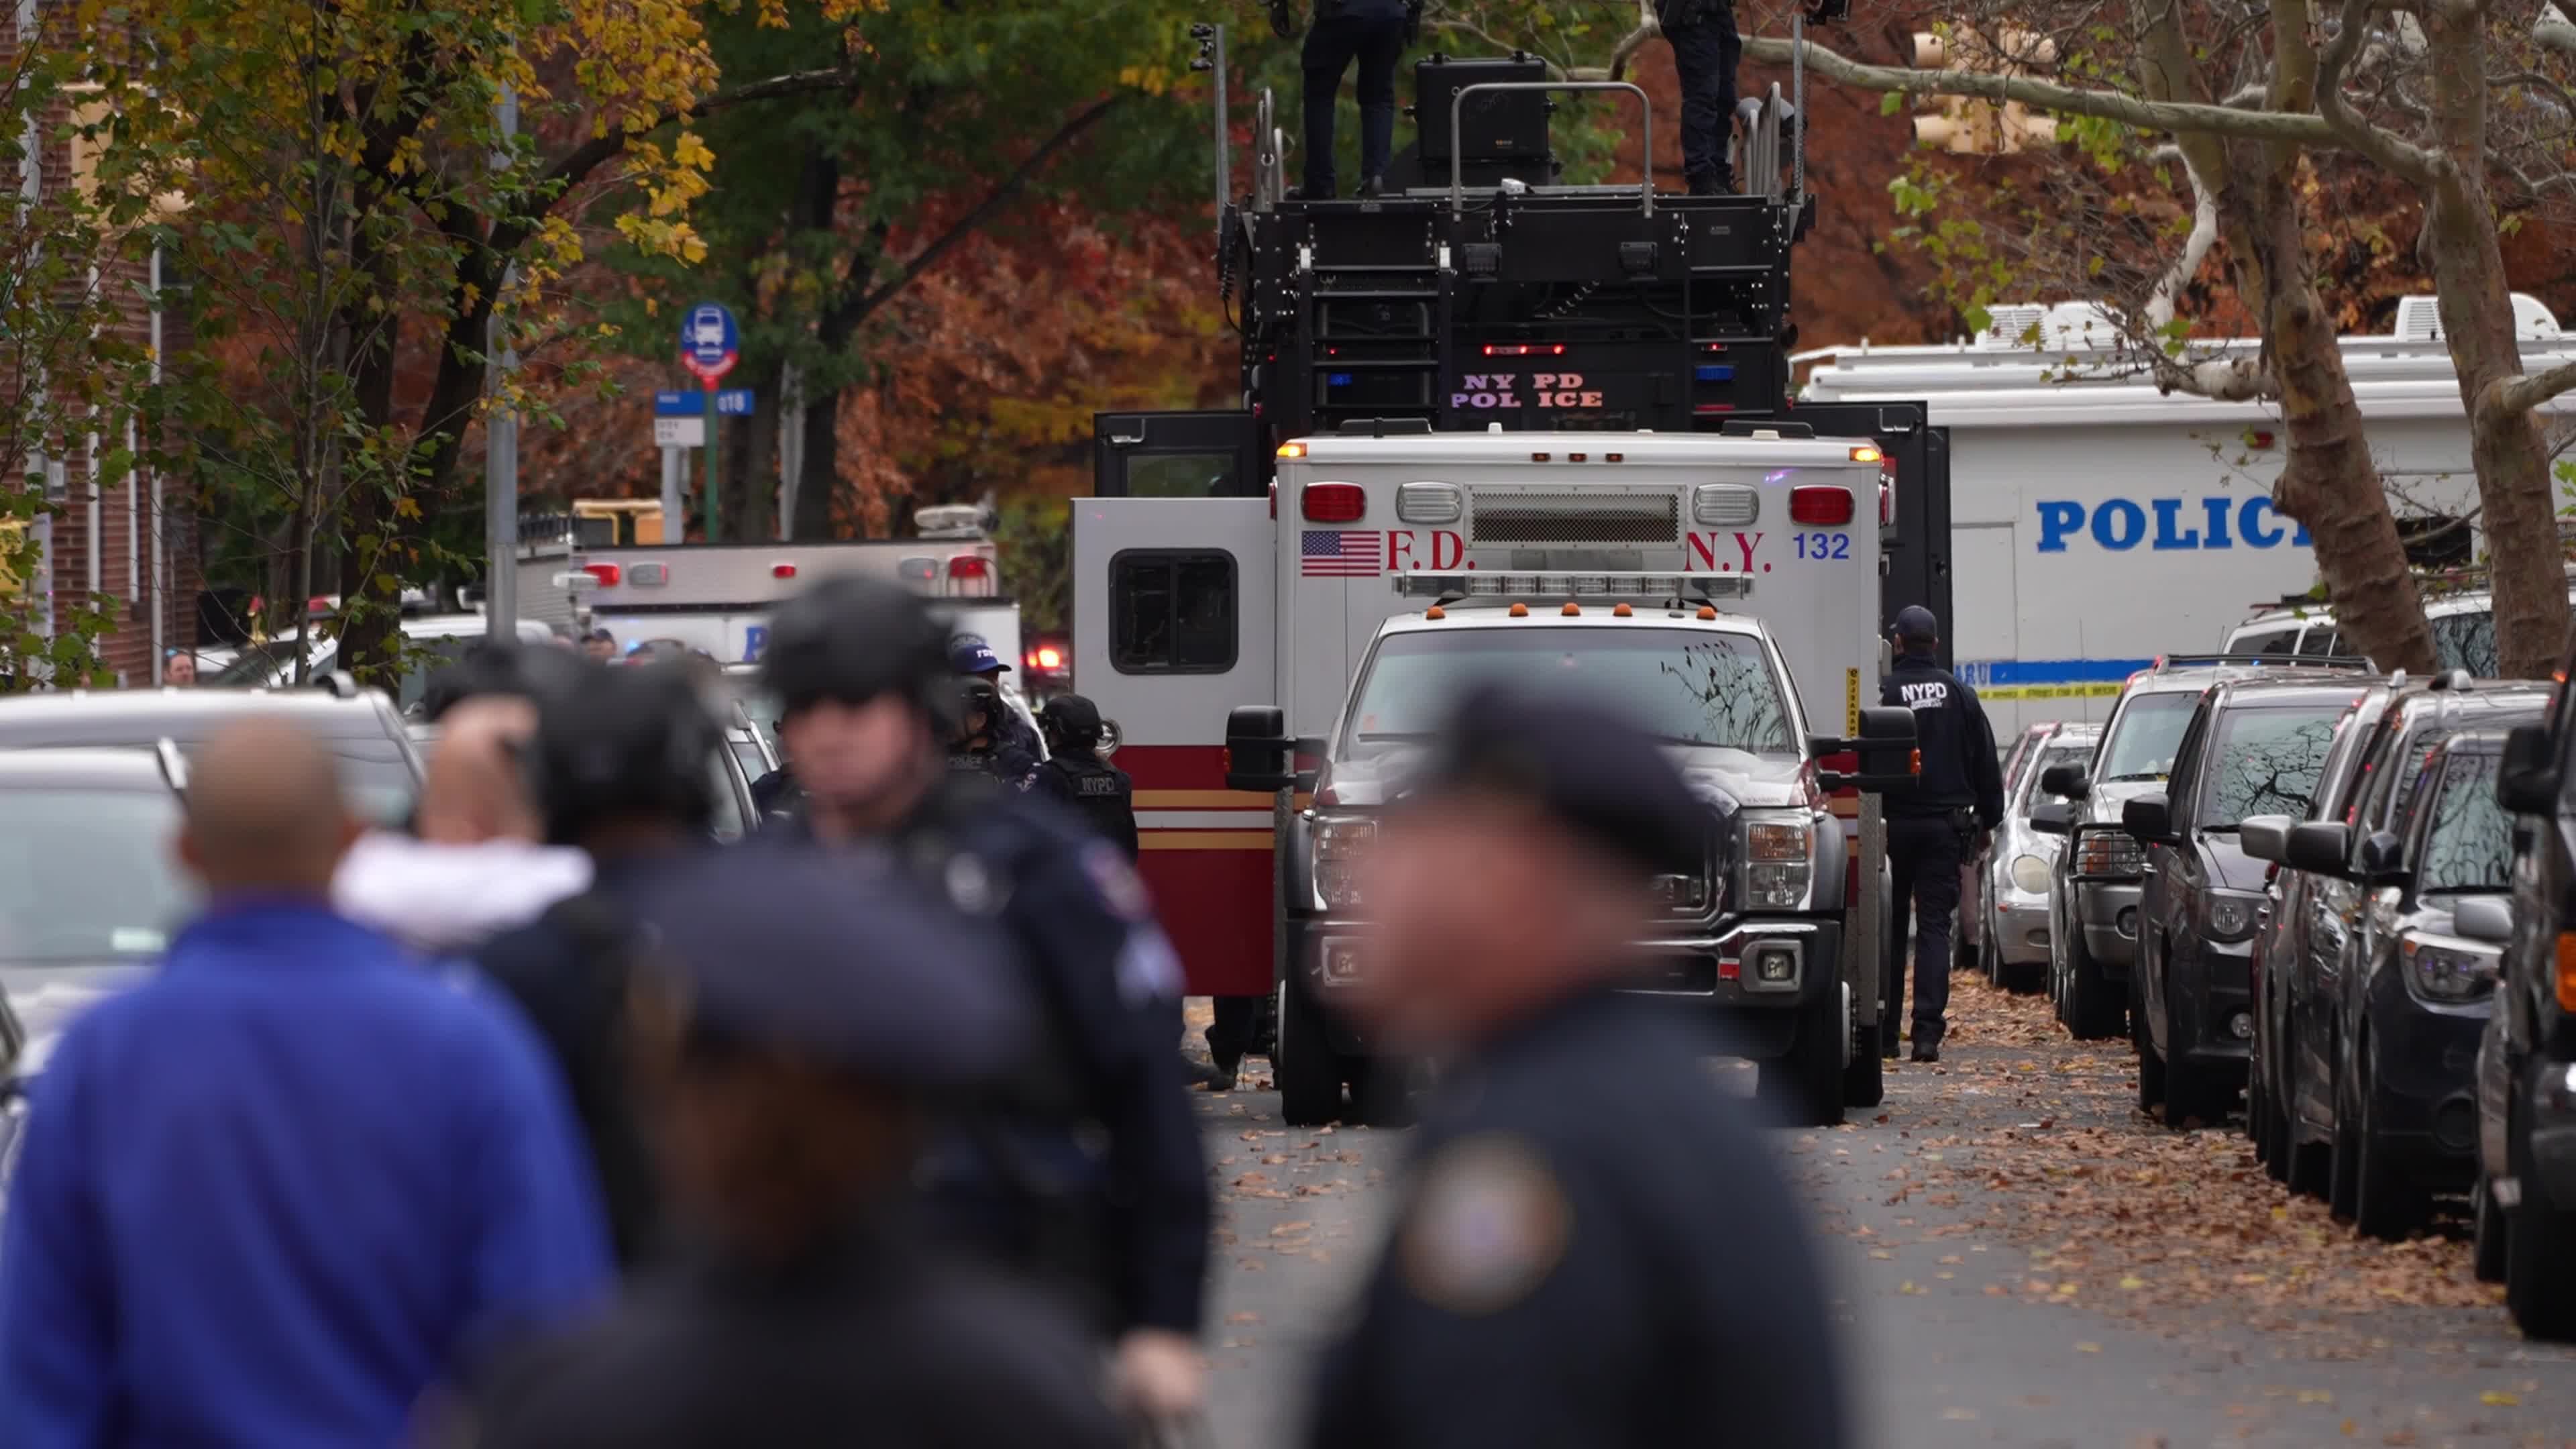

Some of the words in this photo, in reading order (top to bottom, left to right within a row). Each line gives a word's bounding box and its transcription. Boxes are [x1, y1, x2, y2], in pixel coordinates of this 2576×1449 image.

[1387, 531, 1475, 570] F.D.
[1793, 533, 1849, 559] 132
[1901, 682, 1947, 702] NYPD
[1081, 777, 1115, 792] NYPD
